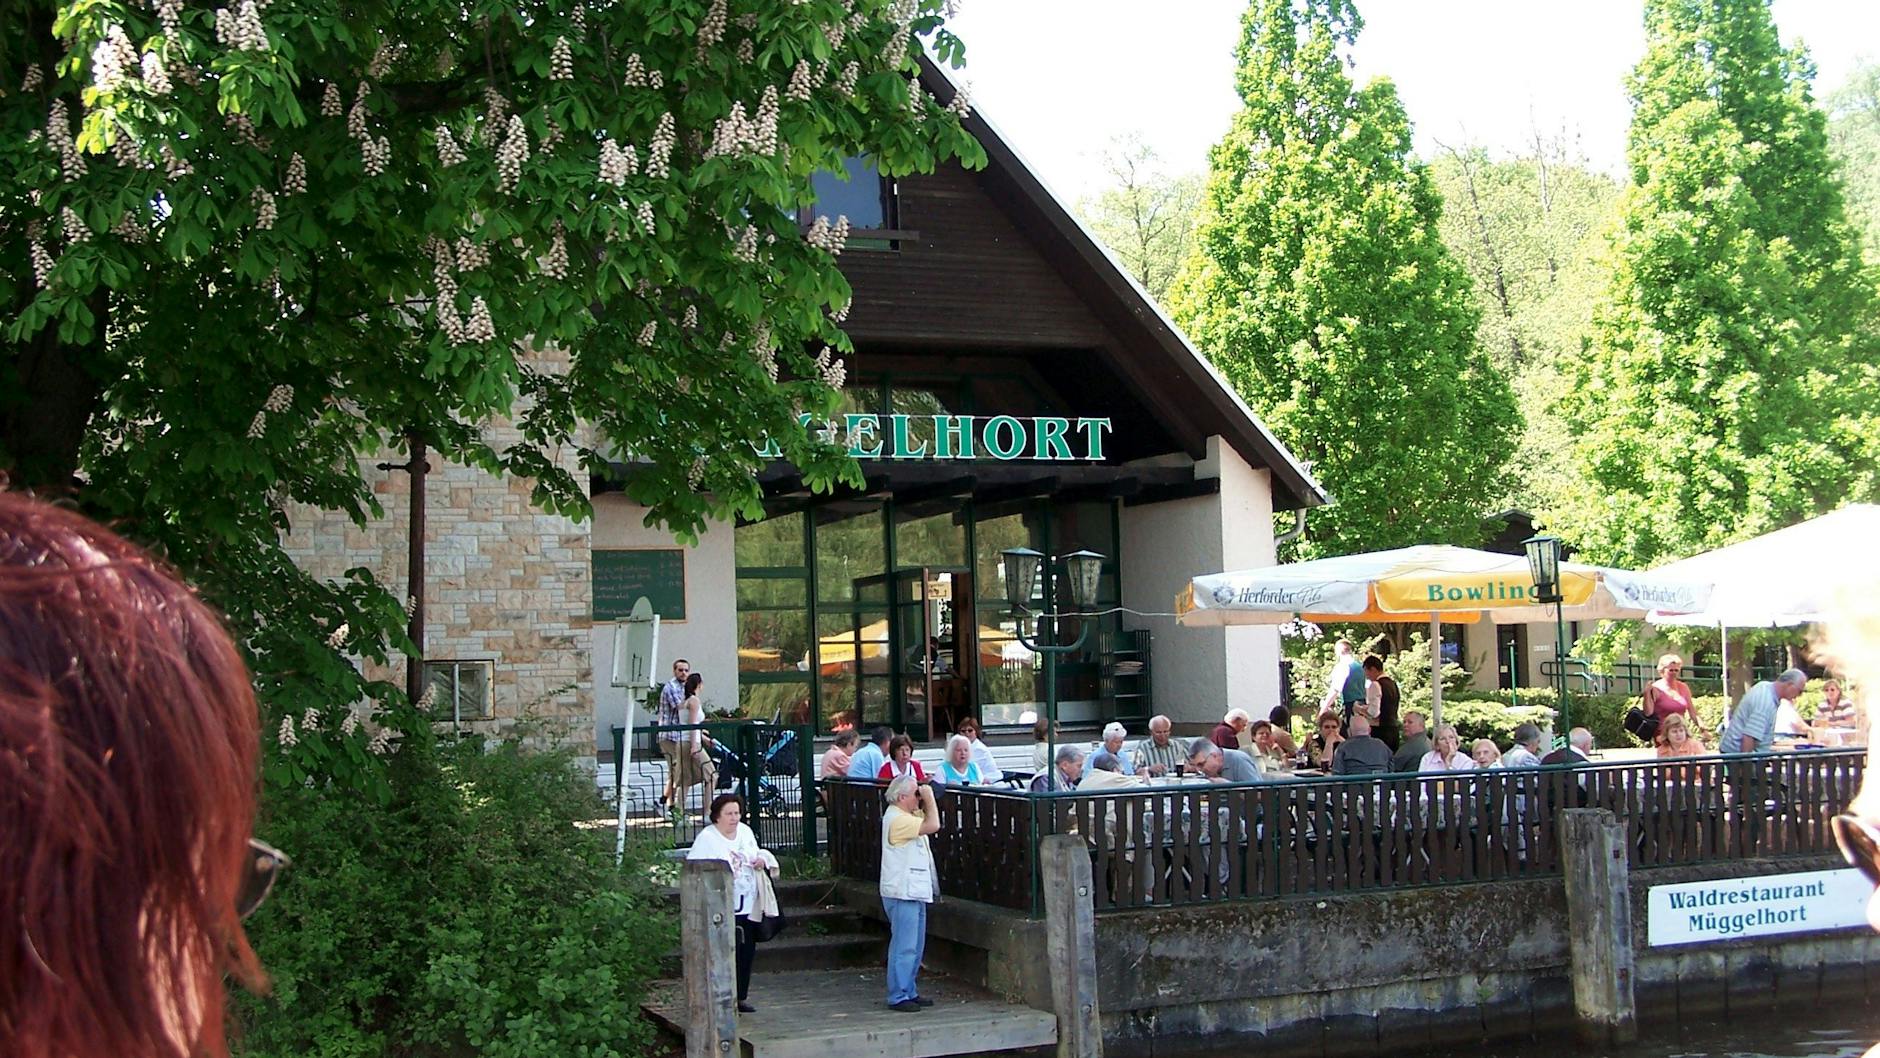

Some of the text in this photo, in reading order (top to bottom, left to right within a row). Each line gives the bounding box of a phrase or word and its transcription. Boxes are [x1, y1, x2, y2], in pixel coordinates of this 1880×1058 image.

[658, 413, 1113, 460] GELHORT
[1239, 587, 1293, 604] Herforder
[1669, 880, 1825, 909] Waldrestaurant
[1689, 905, 1807, 934] Müggelhort
